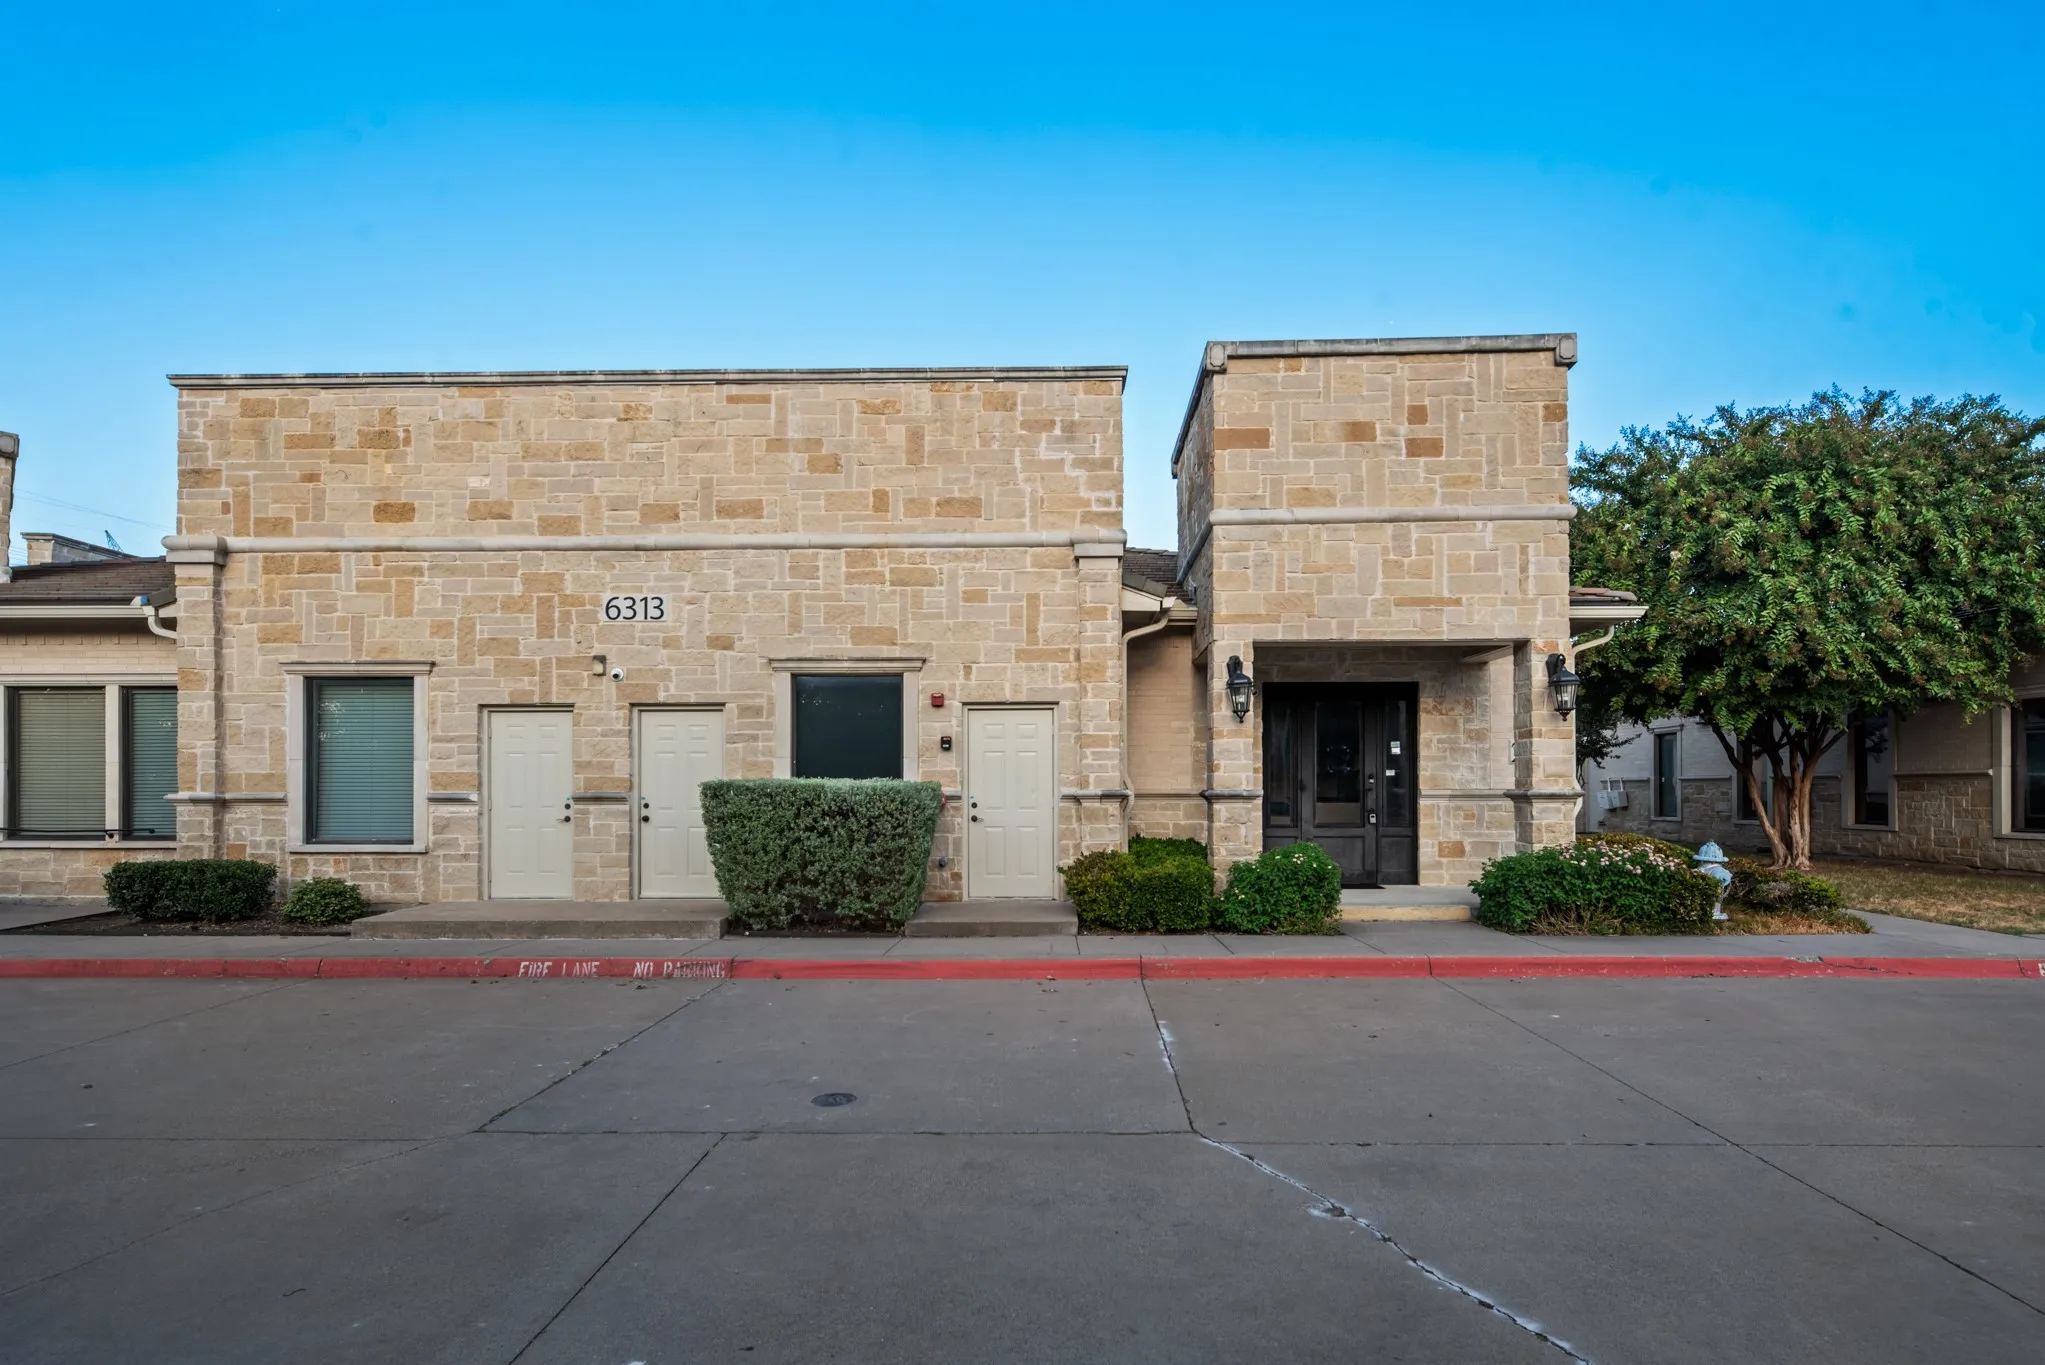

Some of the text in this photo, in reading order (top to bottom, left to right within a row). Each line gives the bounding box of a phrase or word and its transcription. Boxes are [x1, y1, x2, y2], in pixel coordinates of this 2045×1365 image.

[605, 596, 665, 620] 6313
[518, 961, 726, 978] FIRE LANE NO PARKING
